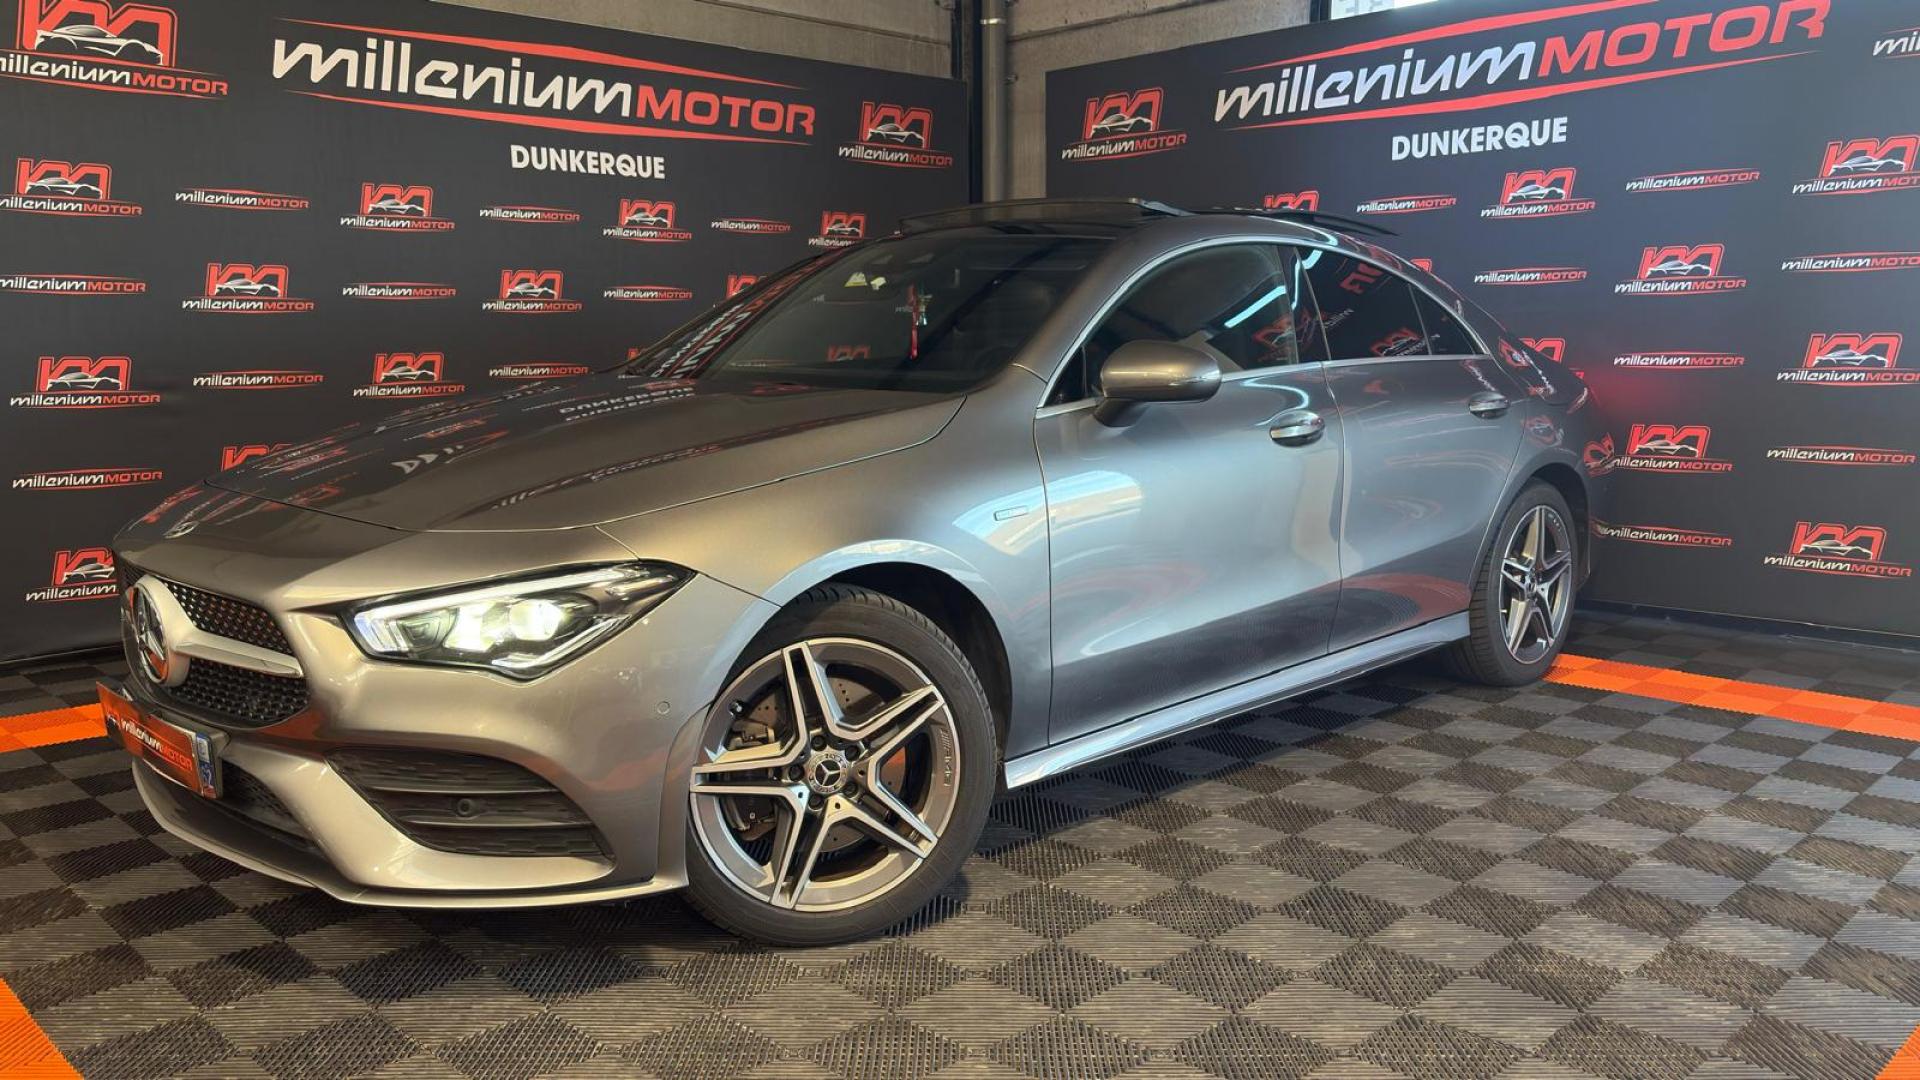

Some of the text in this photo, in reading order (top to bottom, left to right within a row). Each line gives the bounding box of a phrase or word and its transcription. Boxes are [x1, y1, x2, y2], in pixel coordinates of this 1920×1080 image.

[0, 53, 228, 95] illeniumMOTOR
[1392, 117, 1568, 161] DUNKERQUE
[510, 145, 665, 179] DUNKERQUE
